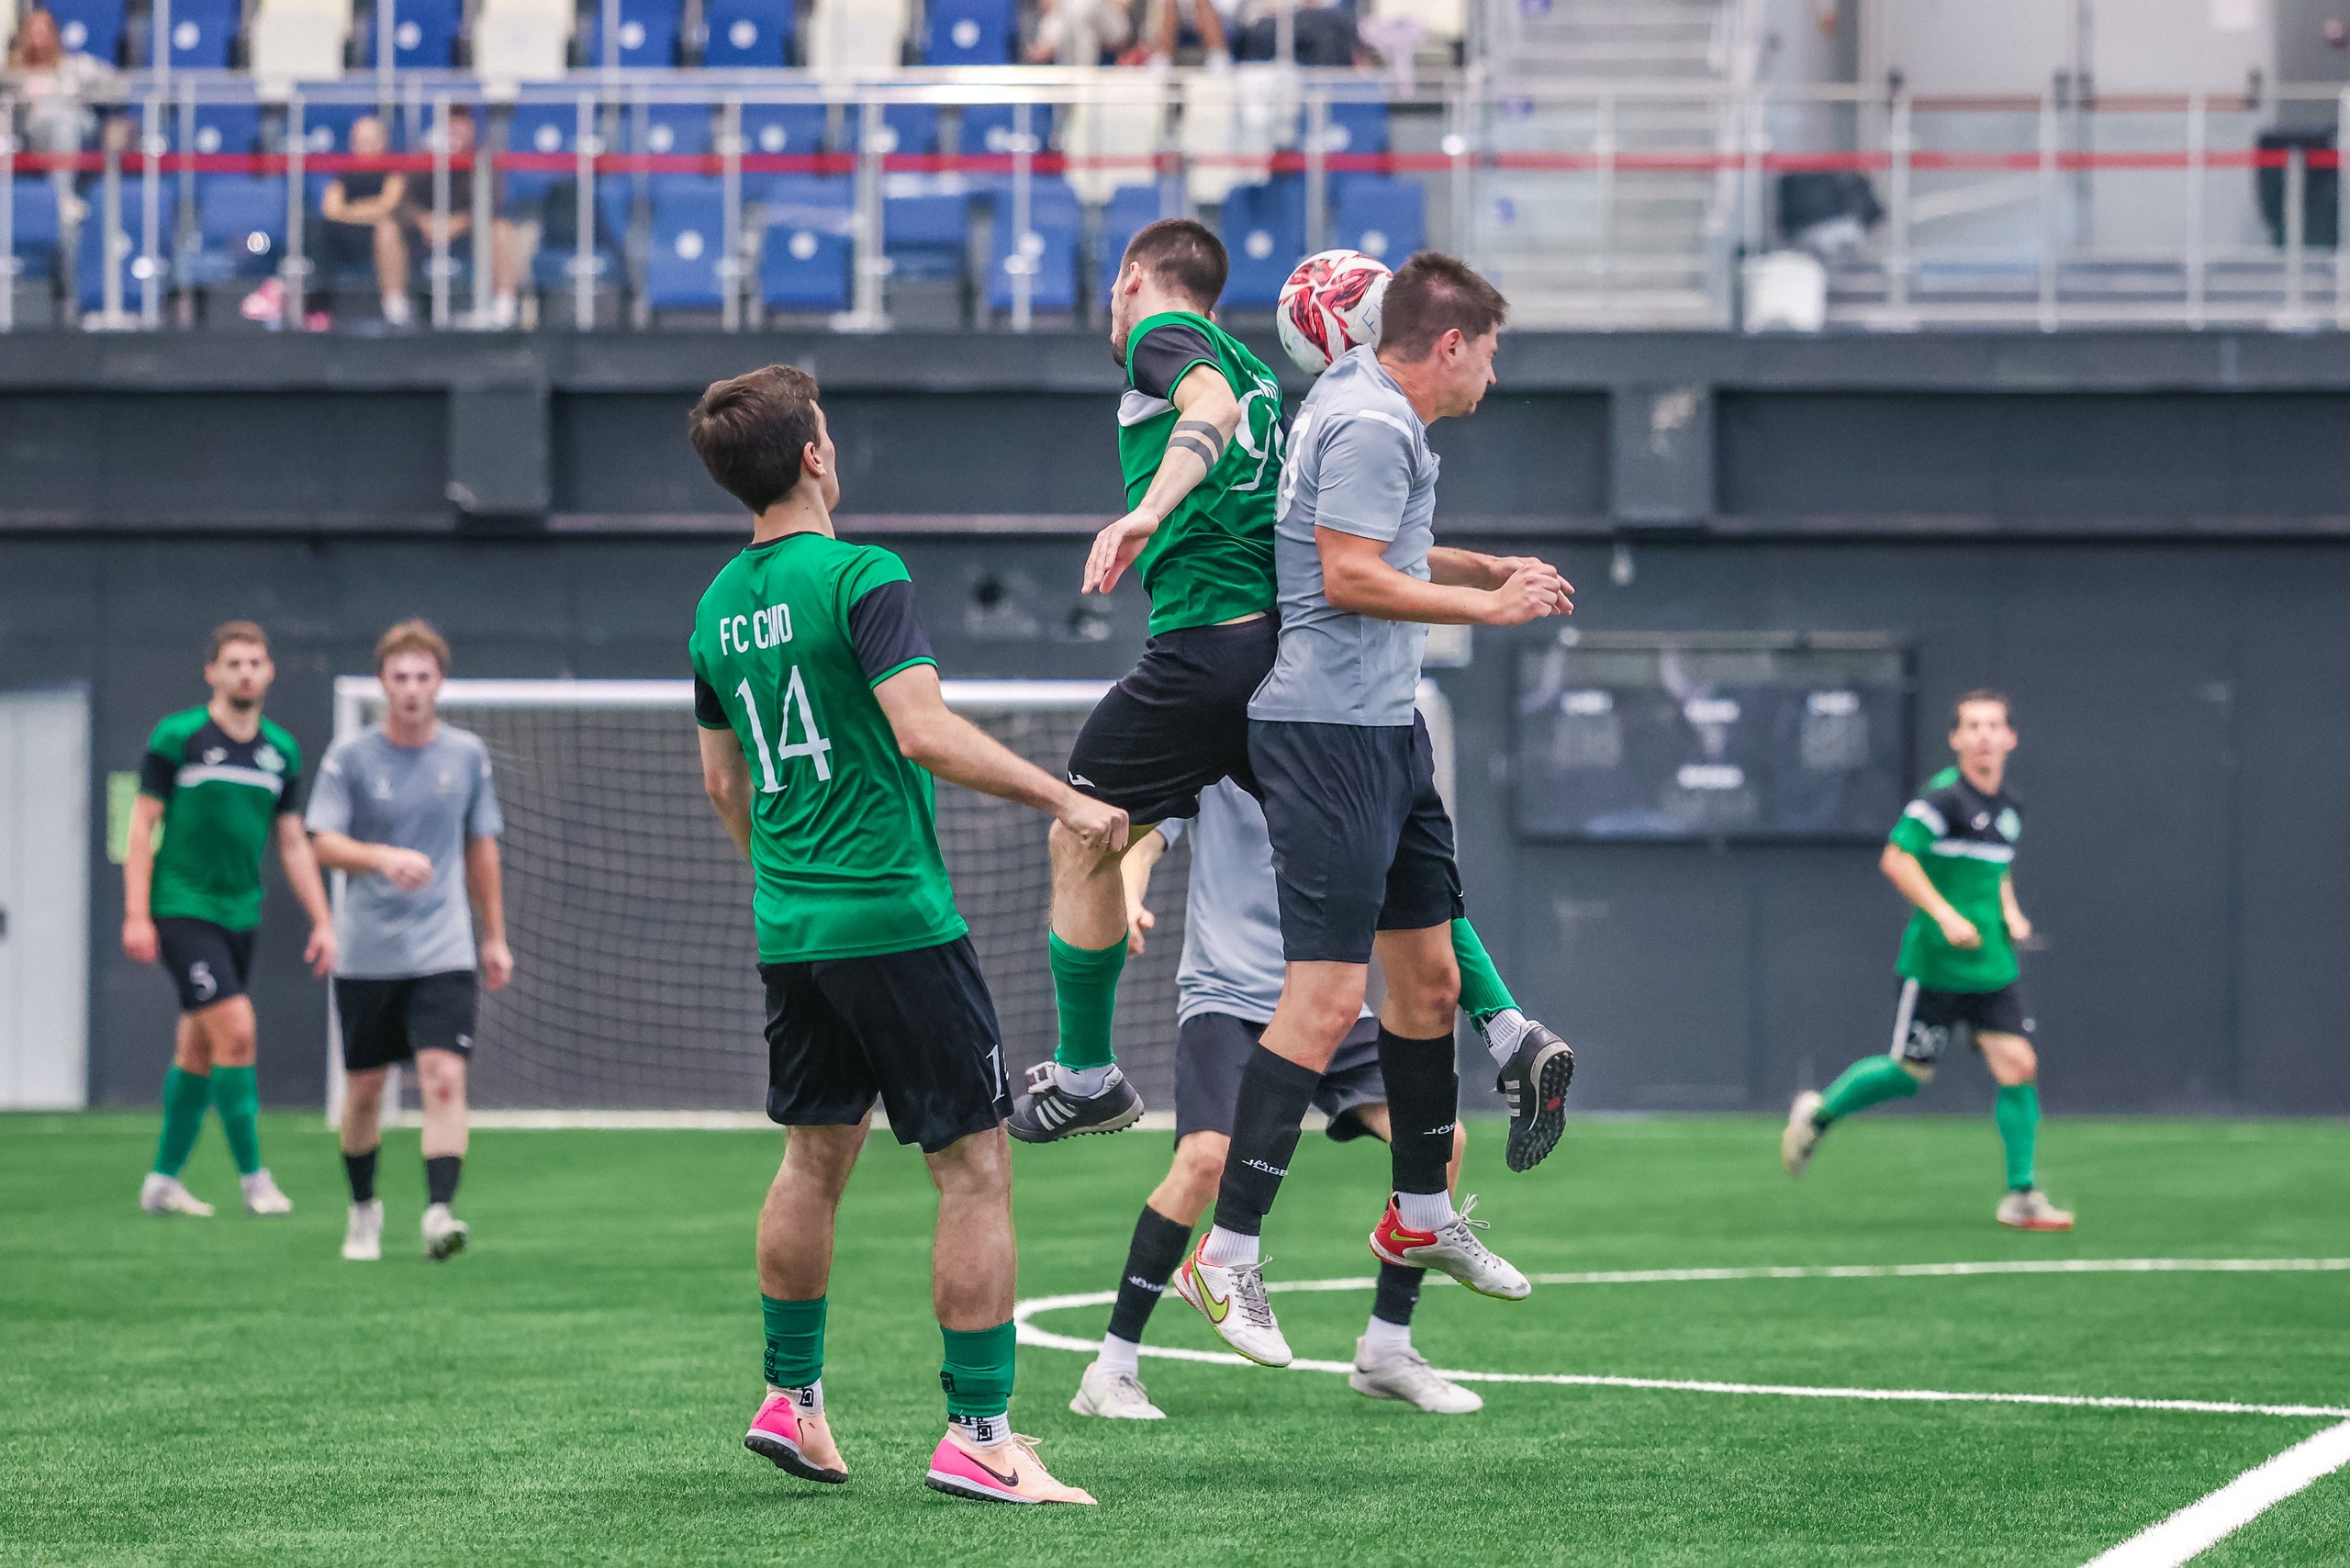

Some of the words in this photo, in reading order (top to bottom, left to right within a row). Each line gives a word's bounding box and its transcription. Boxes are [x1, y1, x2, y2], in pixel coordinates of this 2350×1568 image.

[1229, 389, 1284, 490] 9
[720, 614, 749, 655] FC
[753, 603, 793, 649] CMD
[735, 665, 831, 792] 14
[986, 1045, 1010, 1103] 1
